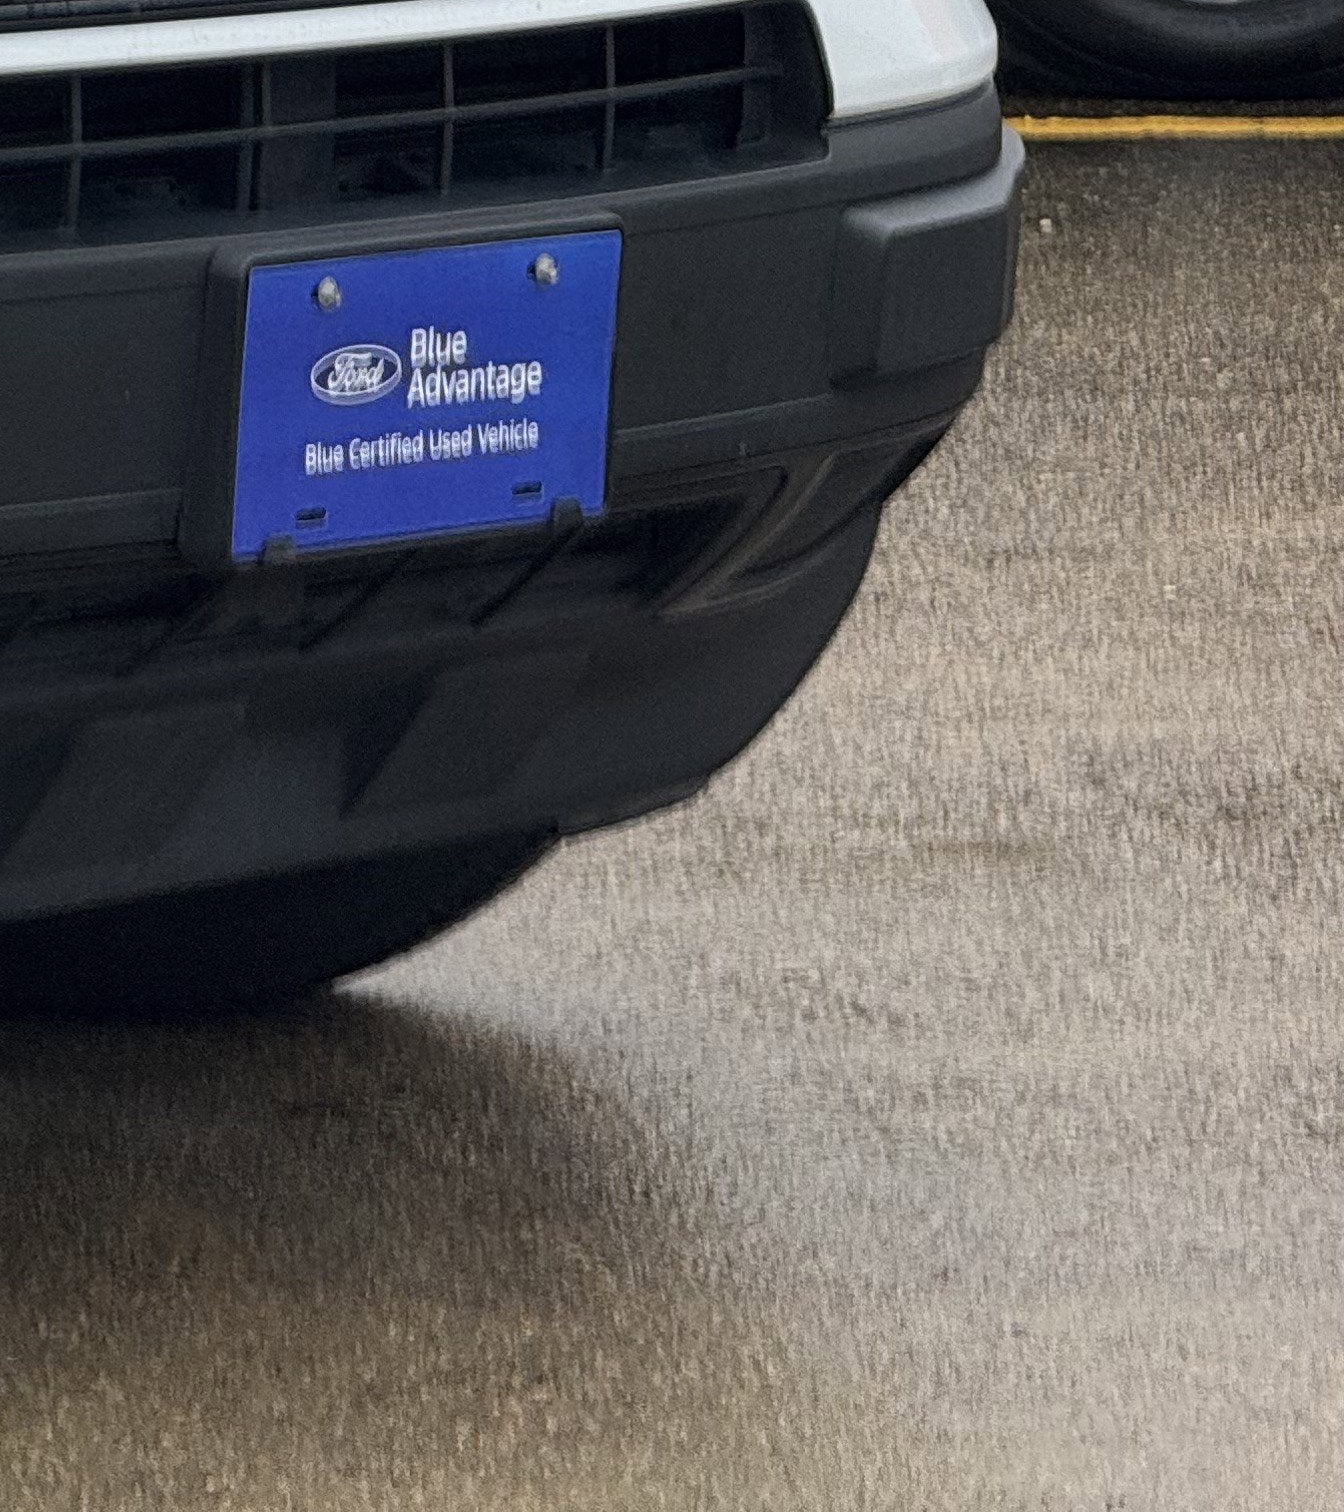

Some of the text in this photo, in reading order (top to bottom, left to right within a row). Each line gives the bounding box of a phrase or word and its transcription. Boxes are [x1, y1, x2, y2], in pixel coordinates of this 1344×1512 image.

[411, 325, 467, 368] Blue
[327, 352, 384, 392] Ford
[407, 360, 542, 409] Advantage
[305, 417, 538, 476] Blue Certified Used Vehicle
